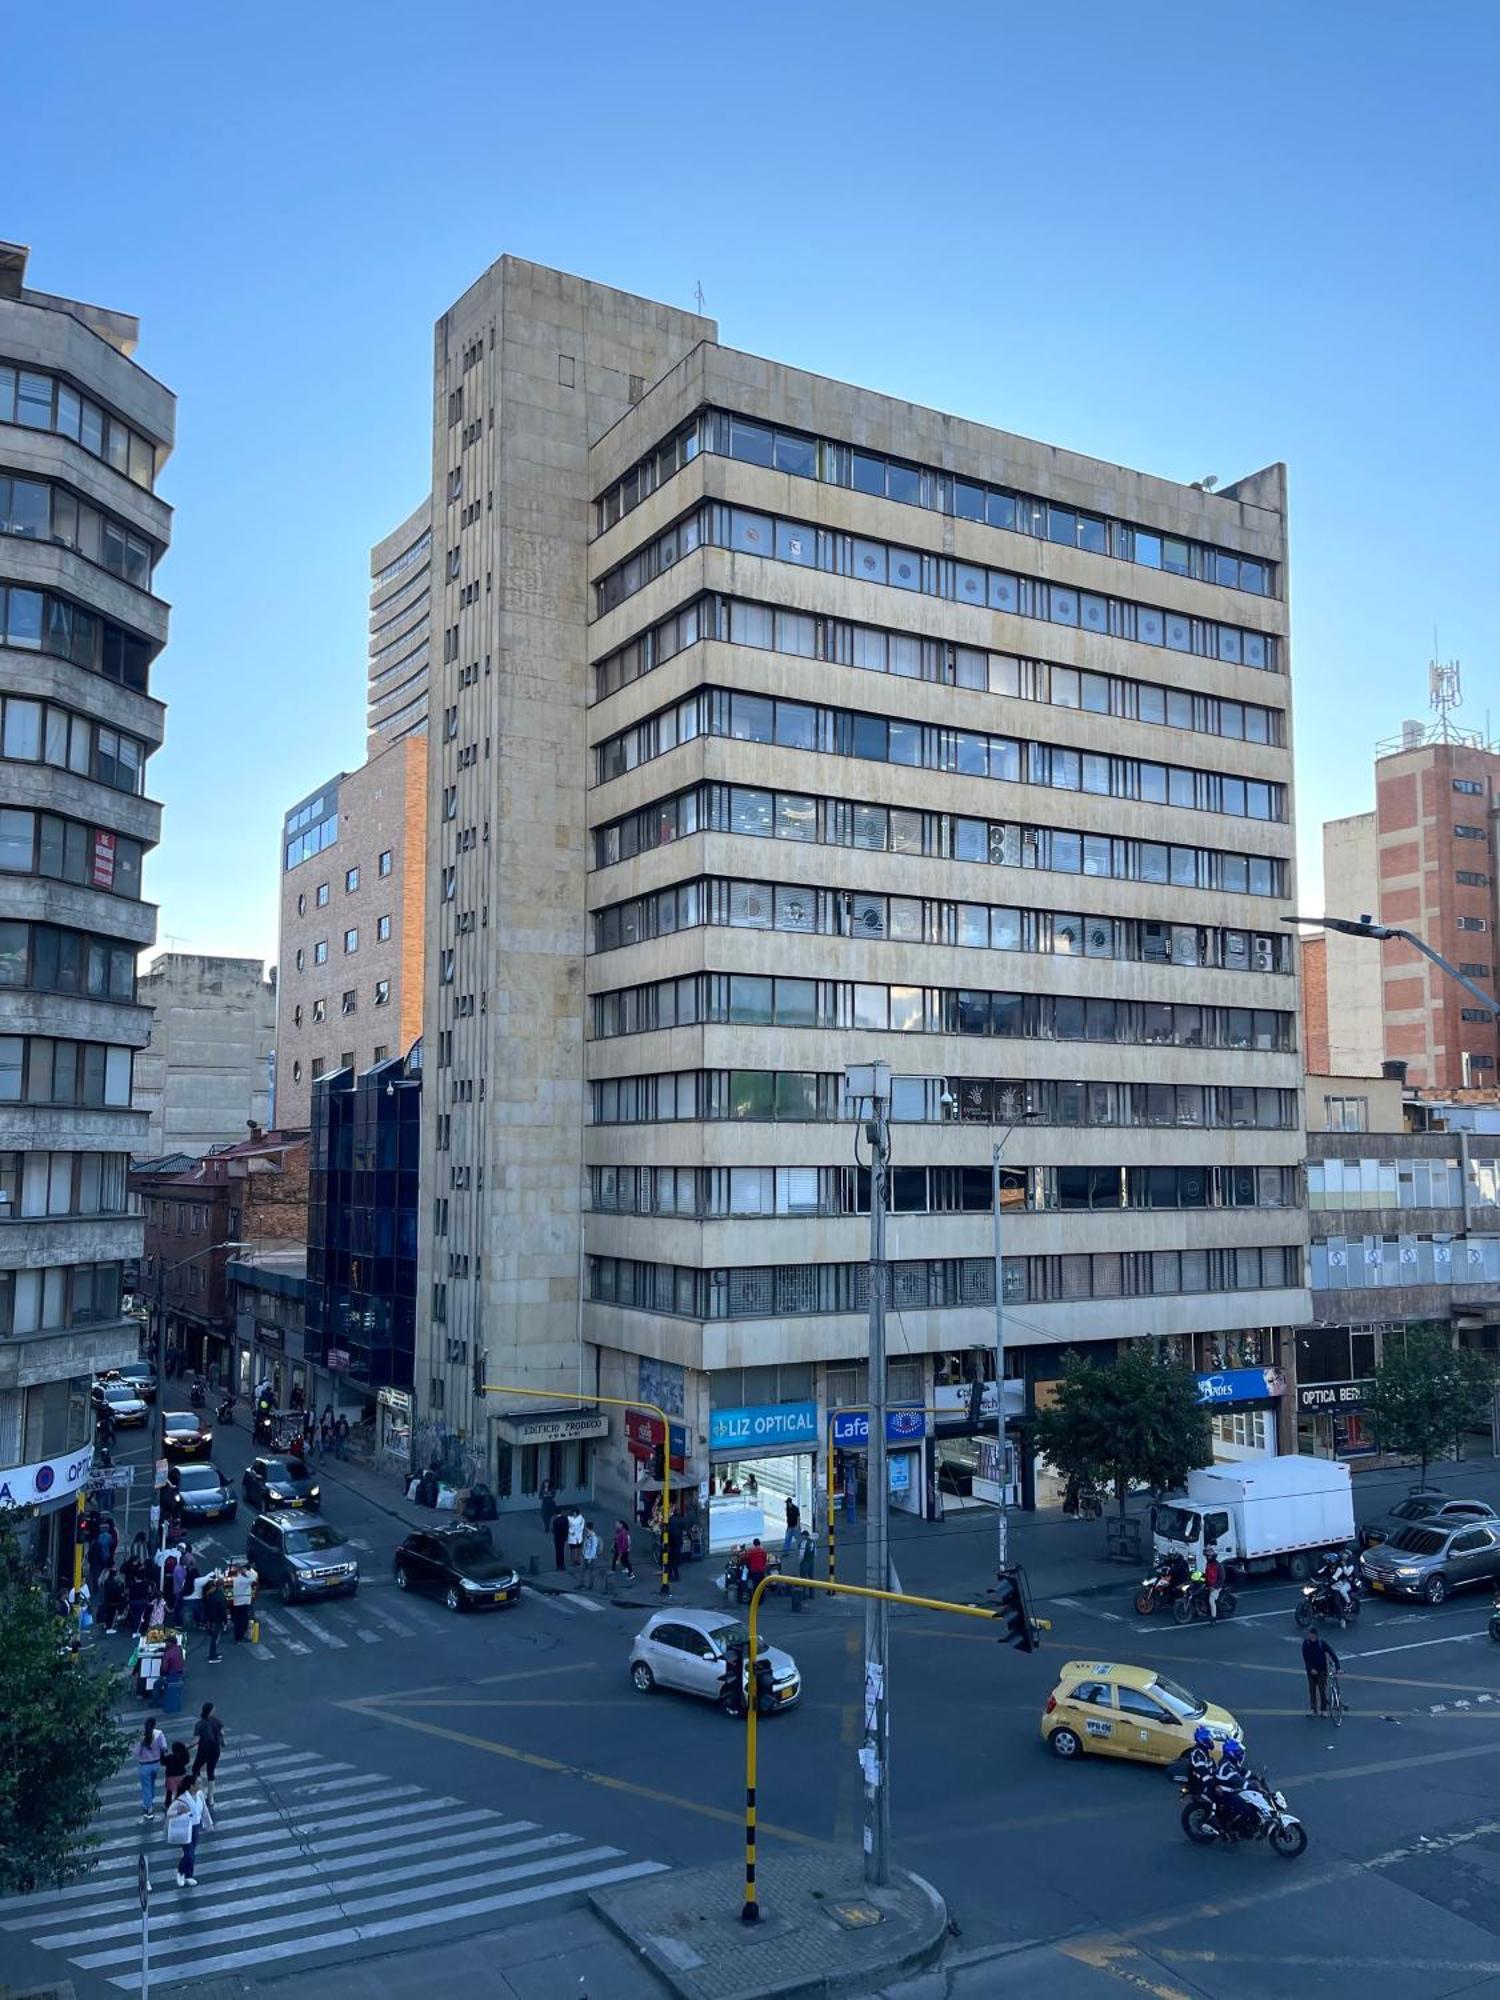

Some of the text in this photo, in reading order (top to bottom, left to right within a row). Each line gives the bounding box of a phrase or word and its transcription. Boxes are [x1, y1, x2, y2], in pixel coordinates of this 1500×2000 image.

[1303, 1389, 1336, 1405] OPTICA
[728, 1413, 814, 1436] LIZ OPTICAL
[835, 1418, 868, 1438] Lafa
